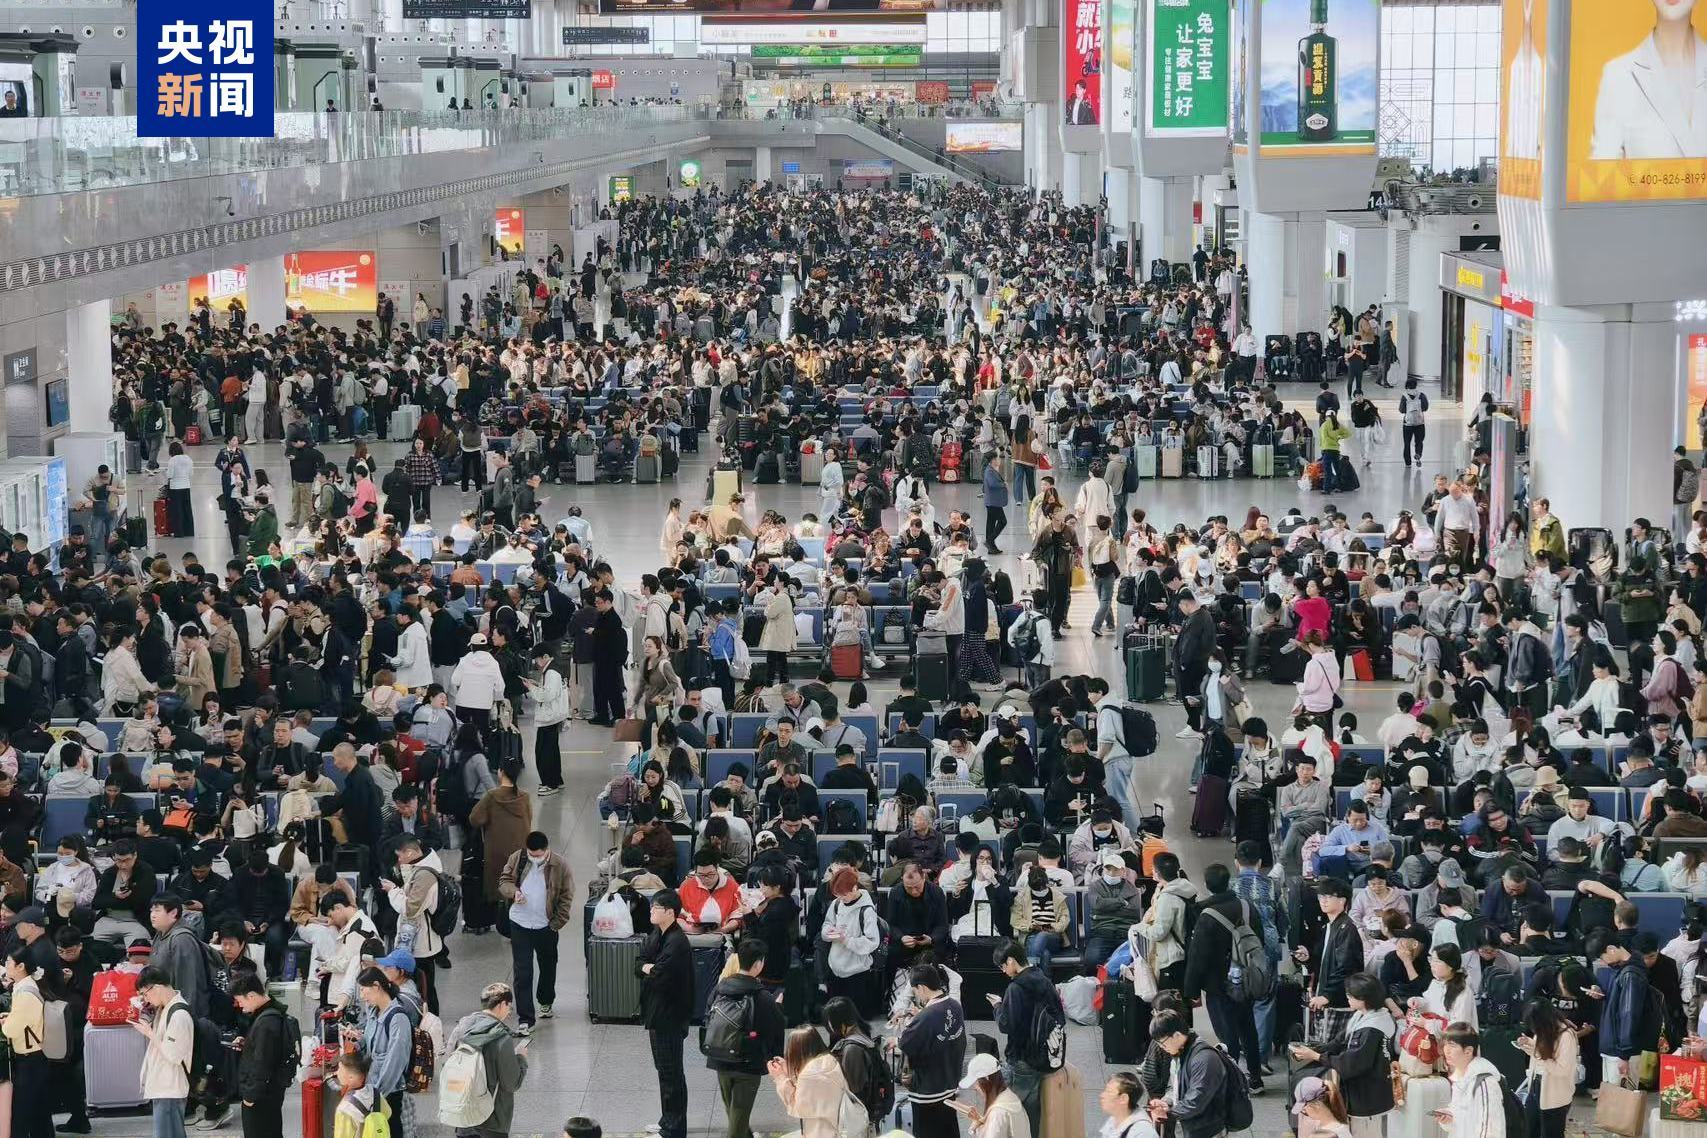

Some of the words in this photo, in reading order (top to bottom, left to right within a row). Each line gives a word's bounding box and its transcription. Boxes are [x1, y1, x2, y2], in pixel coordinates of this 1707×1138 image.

[1175, 23, 1194, 117] 让家更好
[1197, 12, 1214, 80] 兔宝宝
[1640, 173, 1705, 185] 400-826-8199
